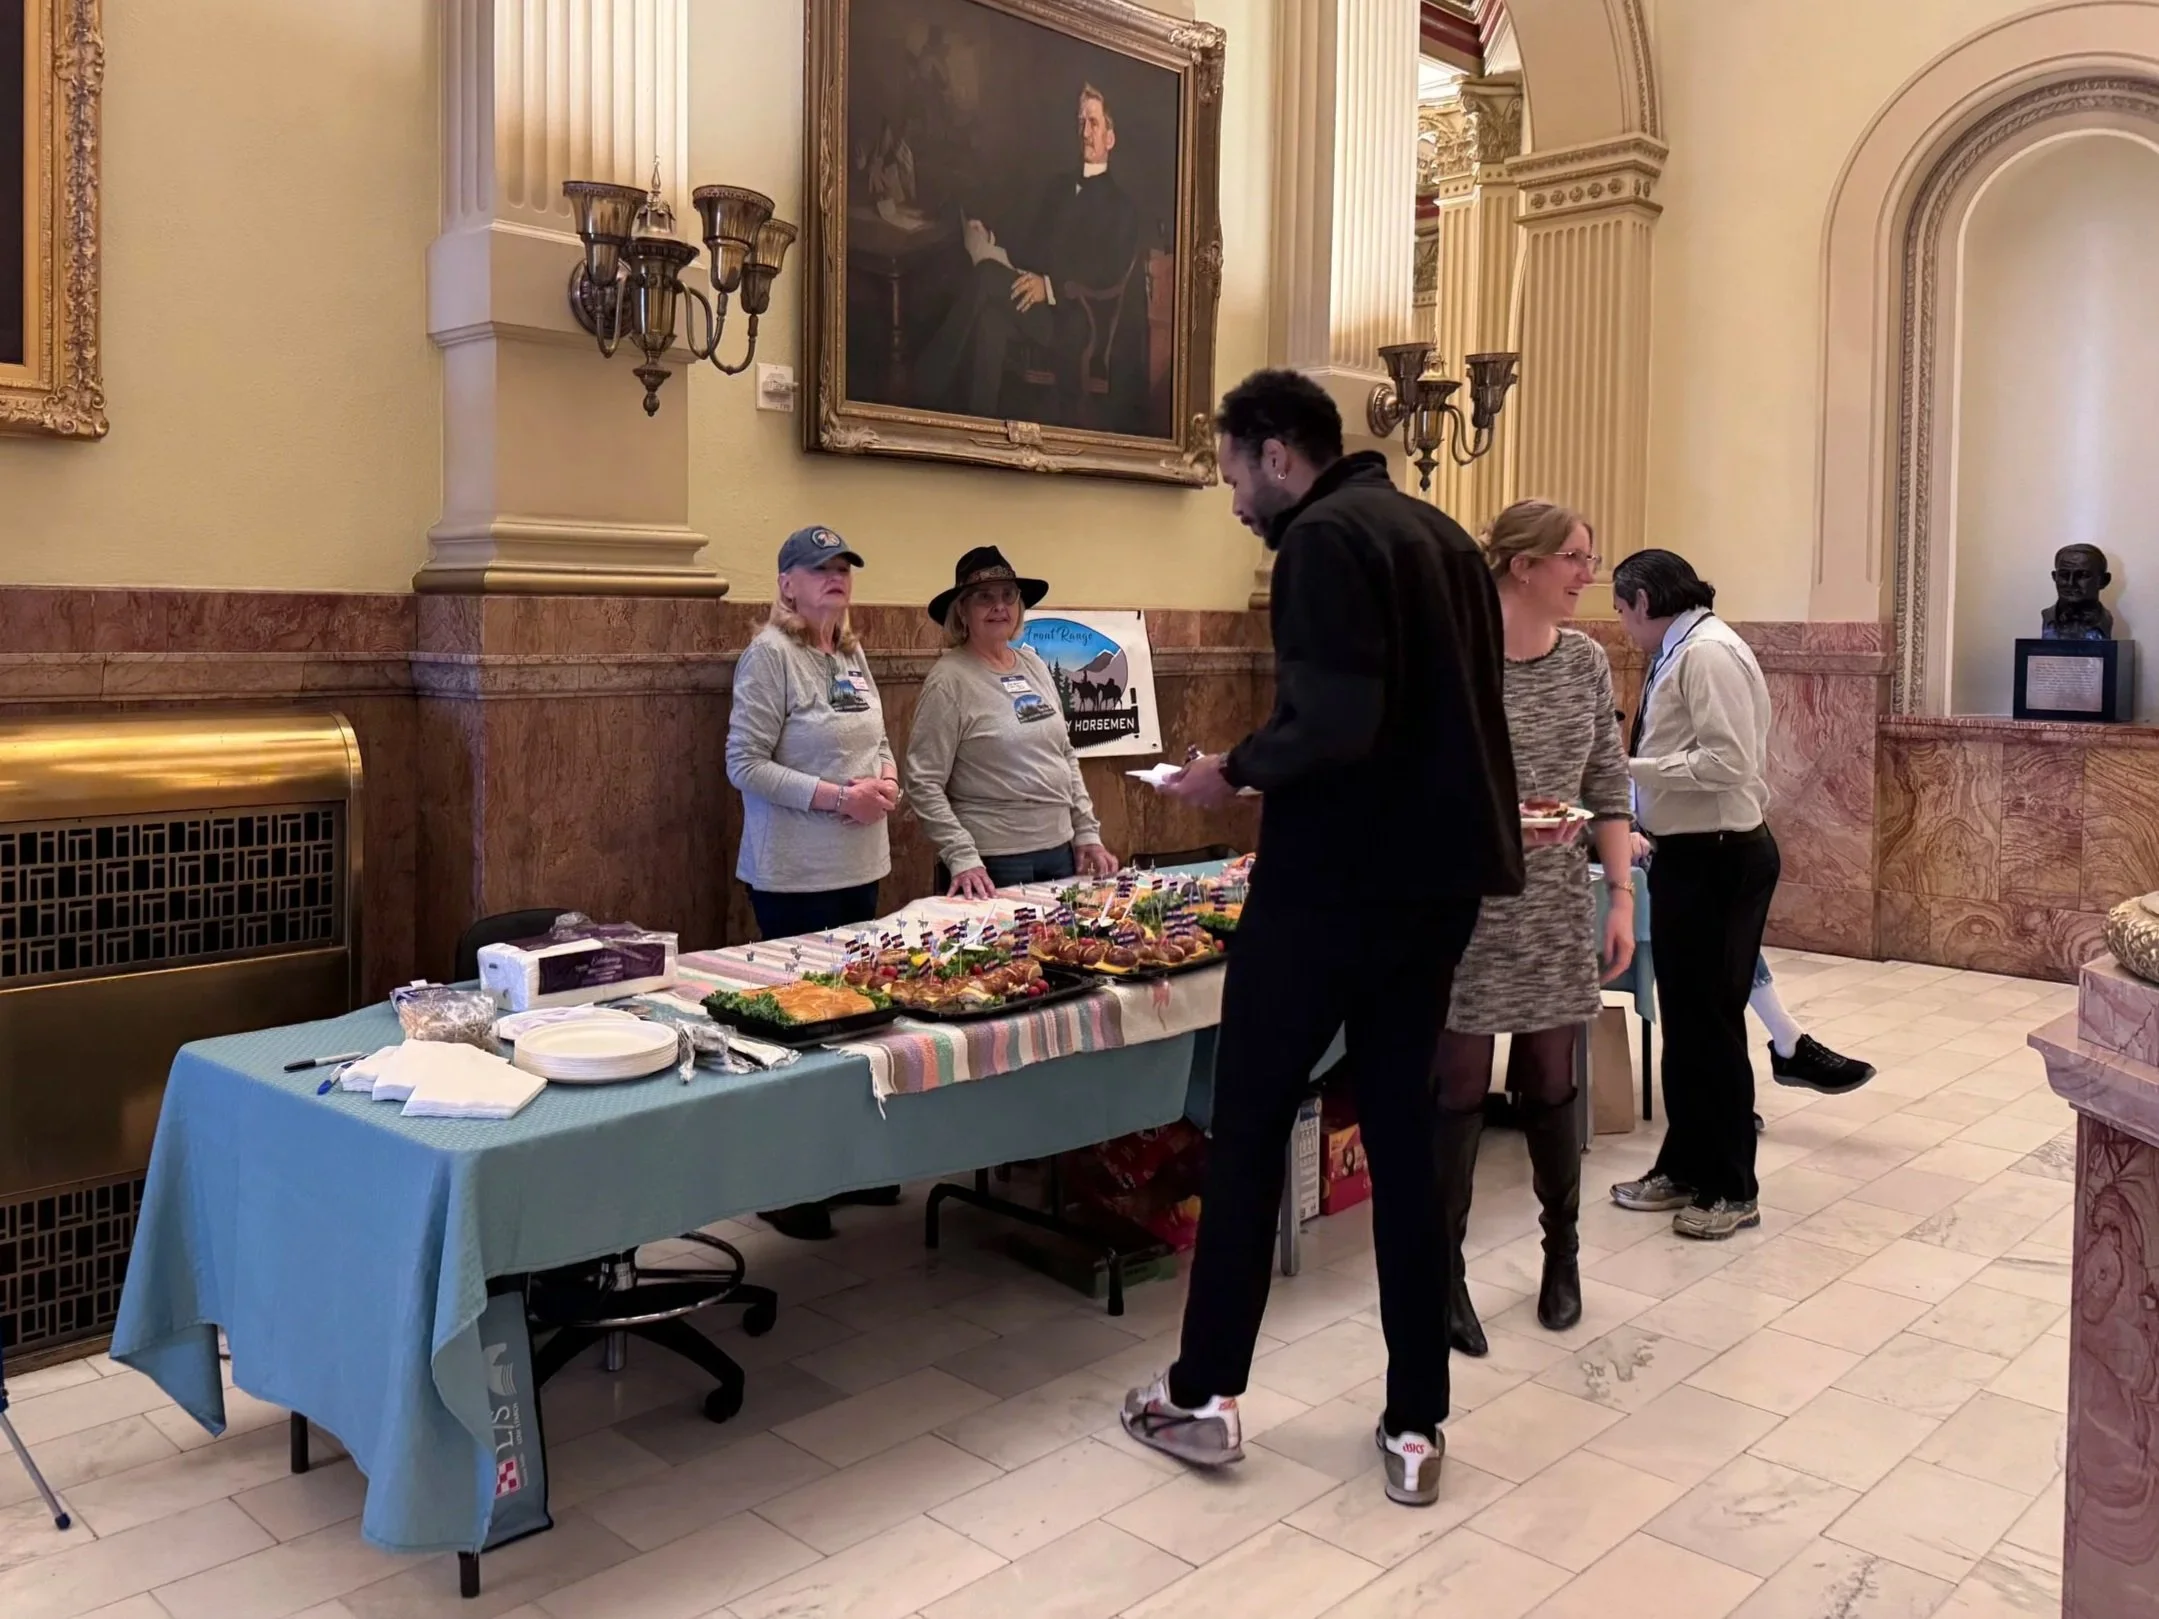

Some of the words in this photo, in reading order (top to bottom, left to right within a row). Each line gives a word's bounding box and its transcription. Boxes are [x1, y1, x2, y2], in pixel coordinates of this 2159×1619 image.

[1024, 625, 1055, 641] Front
[1056, 624, 1092, 646] Range
[1074, 717, 1135, 732] HORSEMEN
